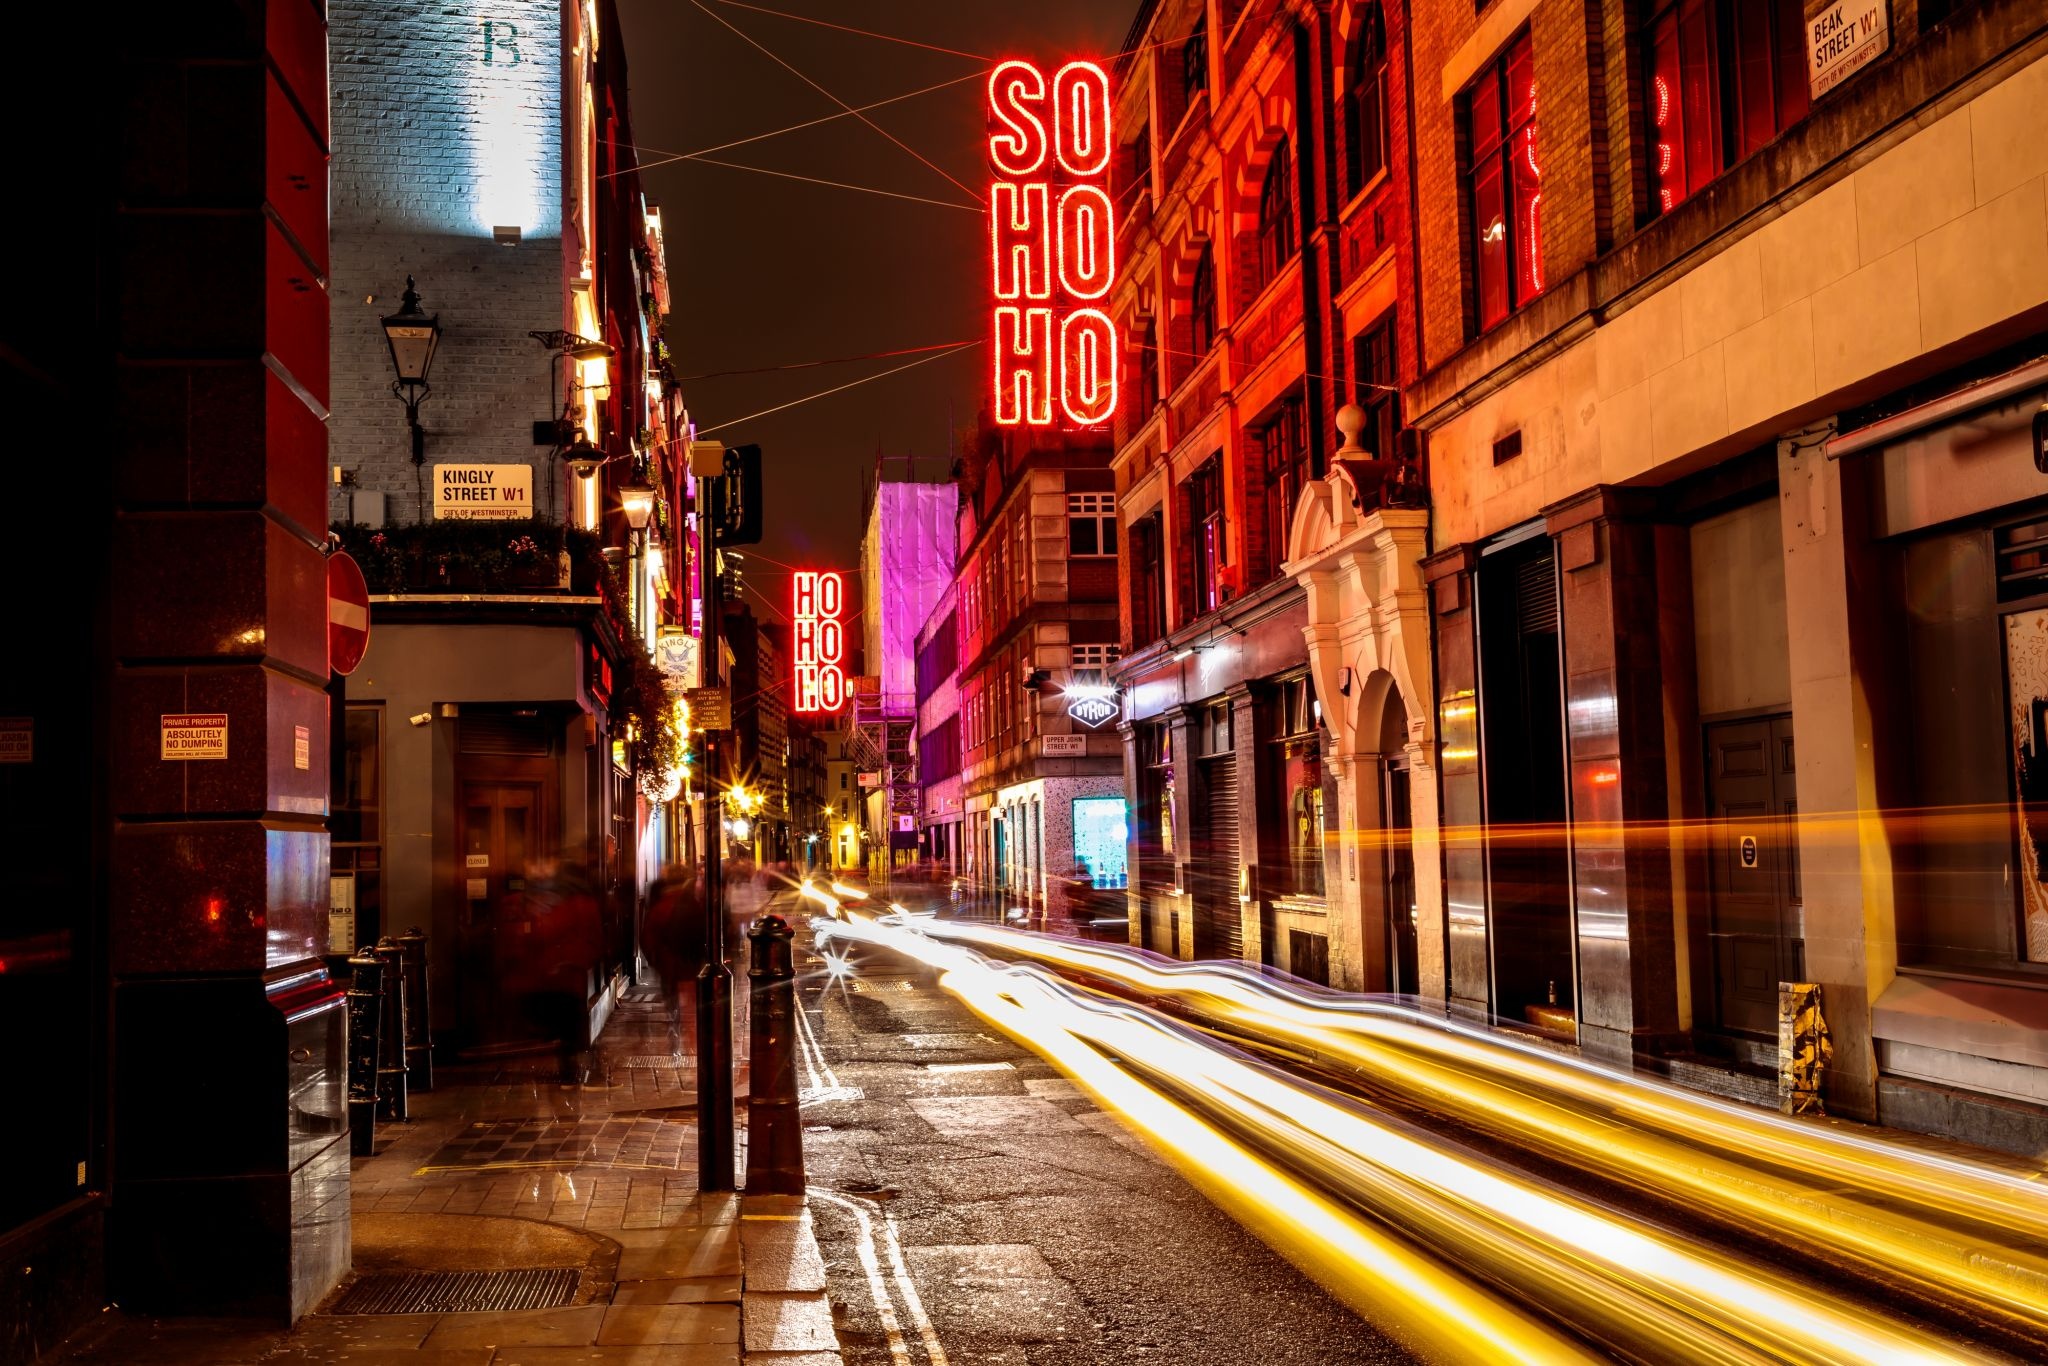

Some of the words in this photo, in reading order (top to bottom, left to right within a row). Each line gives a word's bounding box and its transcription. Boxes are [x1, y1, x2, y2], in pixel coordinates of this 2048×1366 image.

[1814, 6, 1843, 44] BEAK
[1816, 22, 1856, 68] STREET
[1860, 7, 1878, 35] W1
[1818, 76, 1829, 91] CITY
[1830, 69, 1837, 82] OF
[1837, 43, 1877, 77] WESTMINSTER
[988, 60, 1111, 176] SO
[991, 182, 1115, 300] HO
[994, 306, 1118, 425] HO
[443, 470, 494, 484] KINGLY
[443, 487, 497, 501] STREET
[502, 487, 524, 501] W1
[793, 571, 843, 619] HO
[658, 638, 696, 651] KINGLY
[793, 618, 843, 665] HO
[794, 664, 844, 712] HO
[163, 718, 190, 726] PRIVATE
[191, 718, 226, 726] PROPERTY
[1076, 700, 1111, 720] BYRON
[166, 729, 222, 738] ABSOLUTELY
[166, 740, 178, 748] NO
[181, 739, 222, 748] DUMPING
